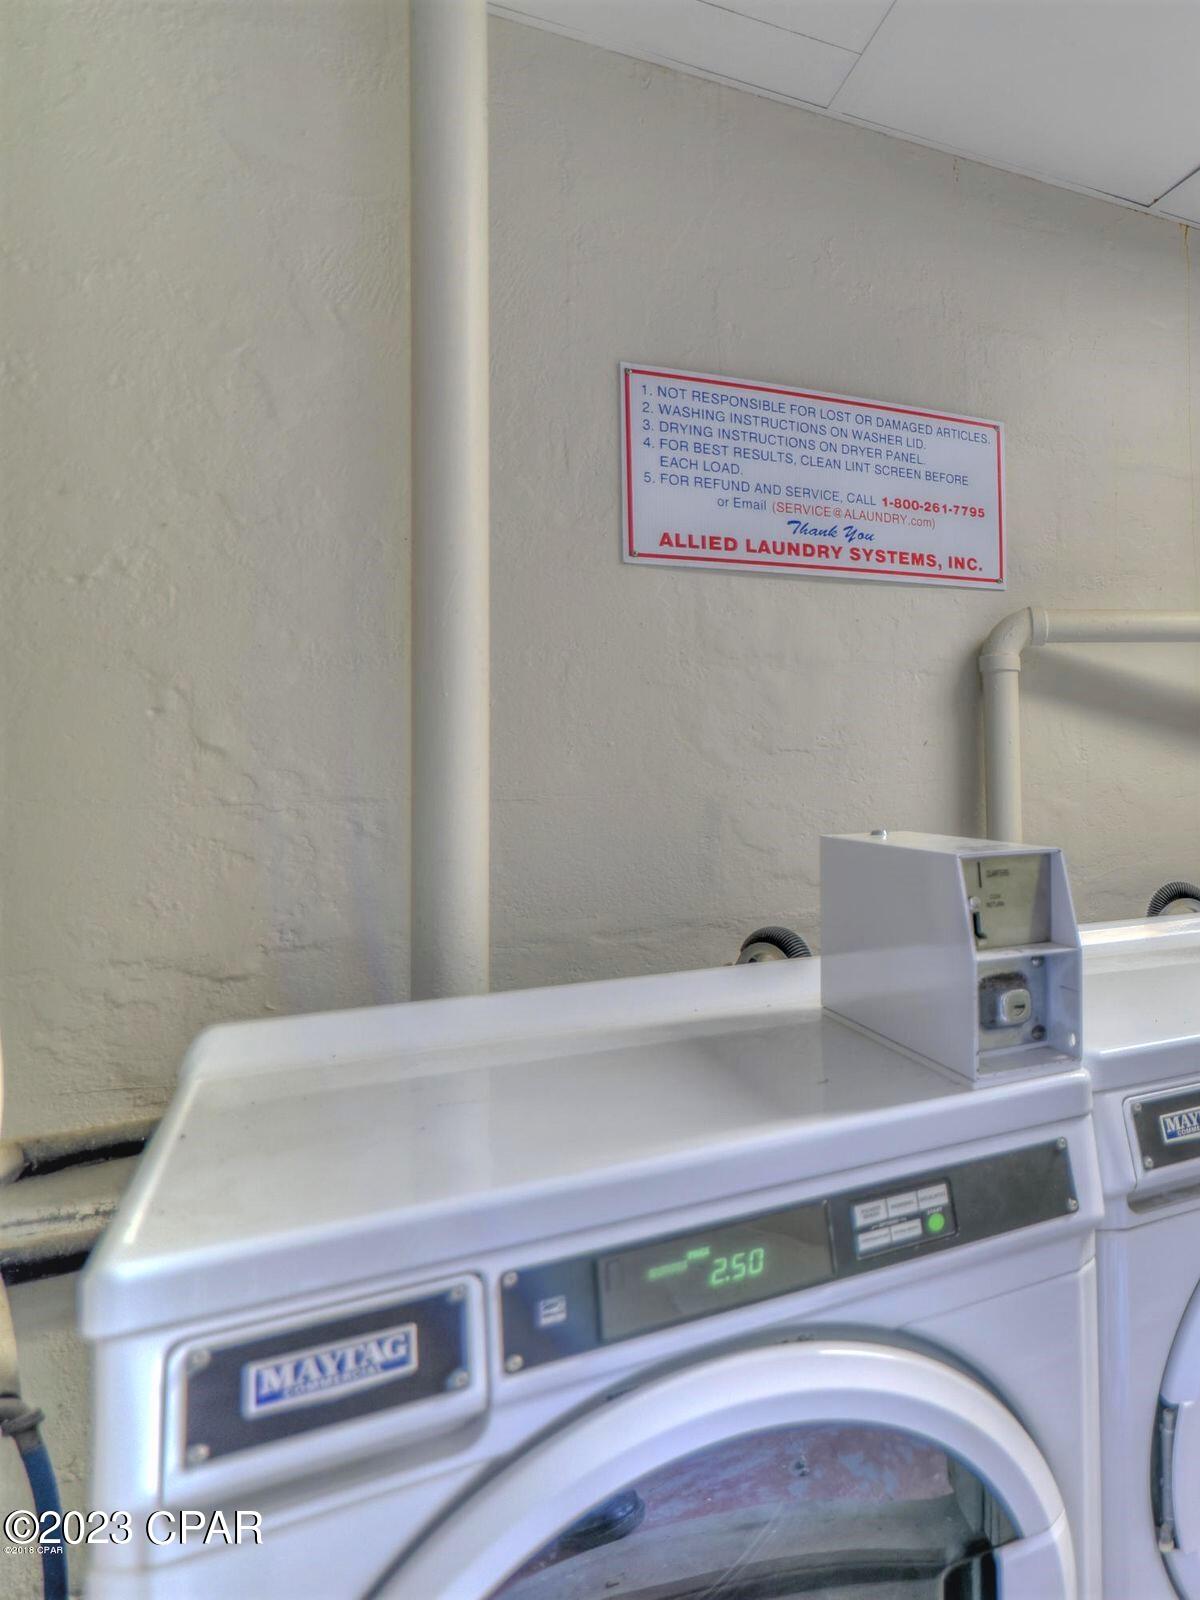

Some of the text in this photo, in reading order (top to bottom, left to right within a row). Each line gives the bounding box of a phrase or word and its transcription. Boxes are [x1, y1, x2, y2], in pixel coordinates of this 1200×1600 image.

[642, 385, 991, 445] 1. NOT RESPONSIBLE FOR LOST OR DAMAGED ARTICLES.
[642, 401, 927, 450] 2. WASHING INSTRUCTIONS ON WASHER LID.
[642, 419, 654, 432] 3.
[659, 421, 713, 438] DRYING
[719, 428, 816, 451] INSTRUCTIONS
[819, 441, 837, 453] ON
[841, 444, 882, 460] DRYER
[643, 437, 969, 486] 4. FOR BEST RESULTS, CLEAN LINT SCREEN BEFORE
[660, 456, 744, 476] EACH LOAD.
[643, 472, 985, 518] 5. FOR REFUND AND SERVICE, CALL 1-800-261-7795
[717, 498, 730, 507] or
[733, 497, 767, 511] Email
[659, 532, 983, 572] ALLIED LAUNDRY SYSTEMS, INC.
[787, 520, 876, 543] Thank You
[710, 1247, 765, 1285] 2.50
[261, 1333, 410, 1396] MAYTAG
